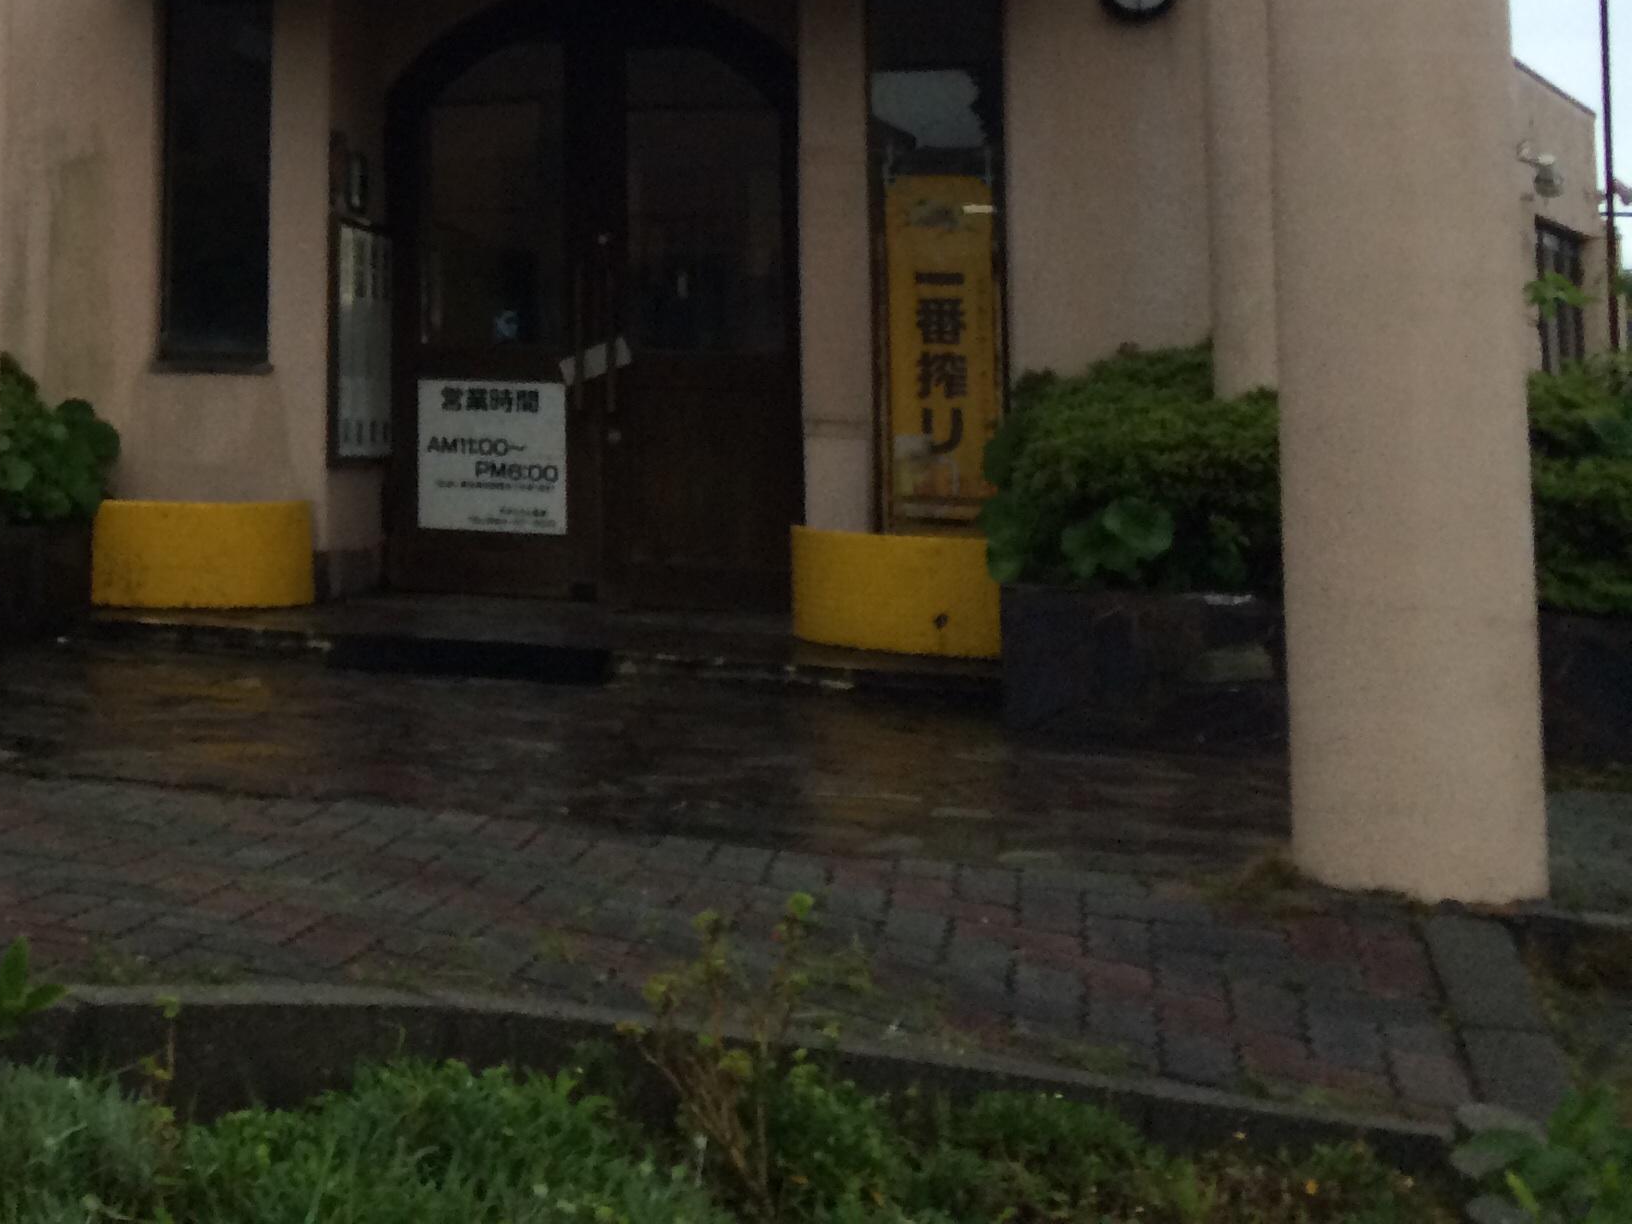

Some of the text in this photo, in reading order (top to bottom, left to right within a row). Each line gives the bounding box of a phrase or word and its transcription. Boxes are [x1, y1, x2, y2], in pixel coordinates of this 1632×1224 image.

[441, 387, 539, 413] 営業時間
[915, 271, 967, 452] 一番搾り
